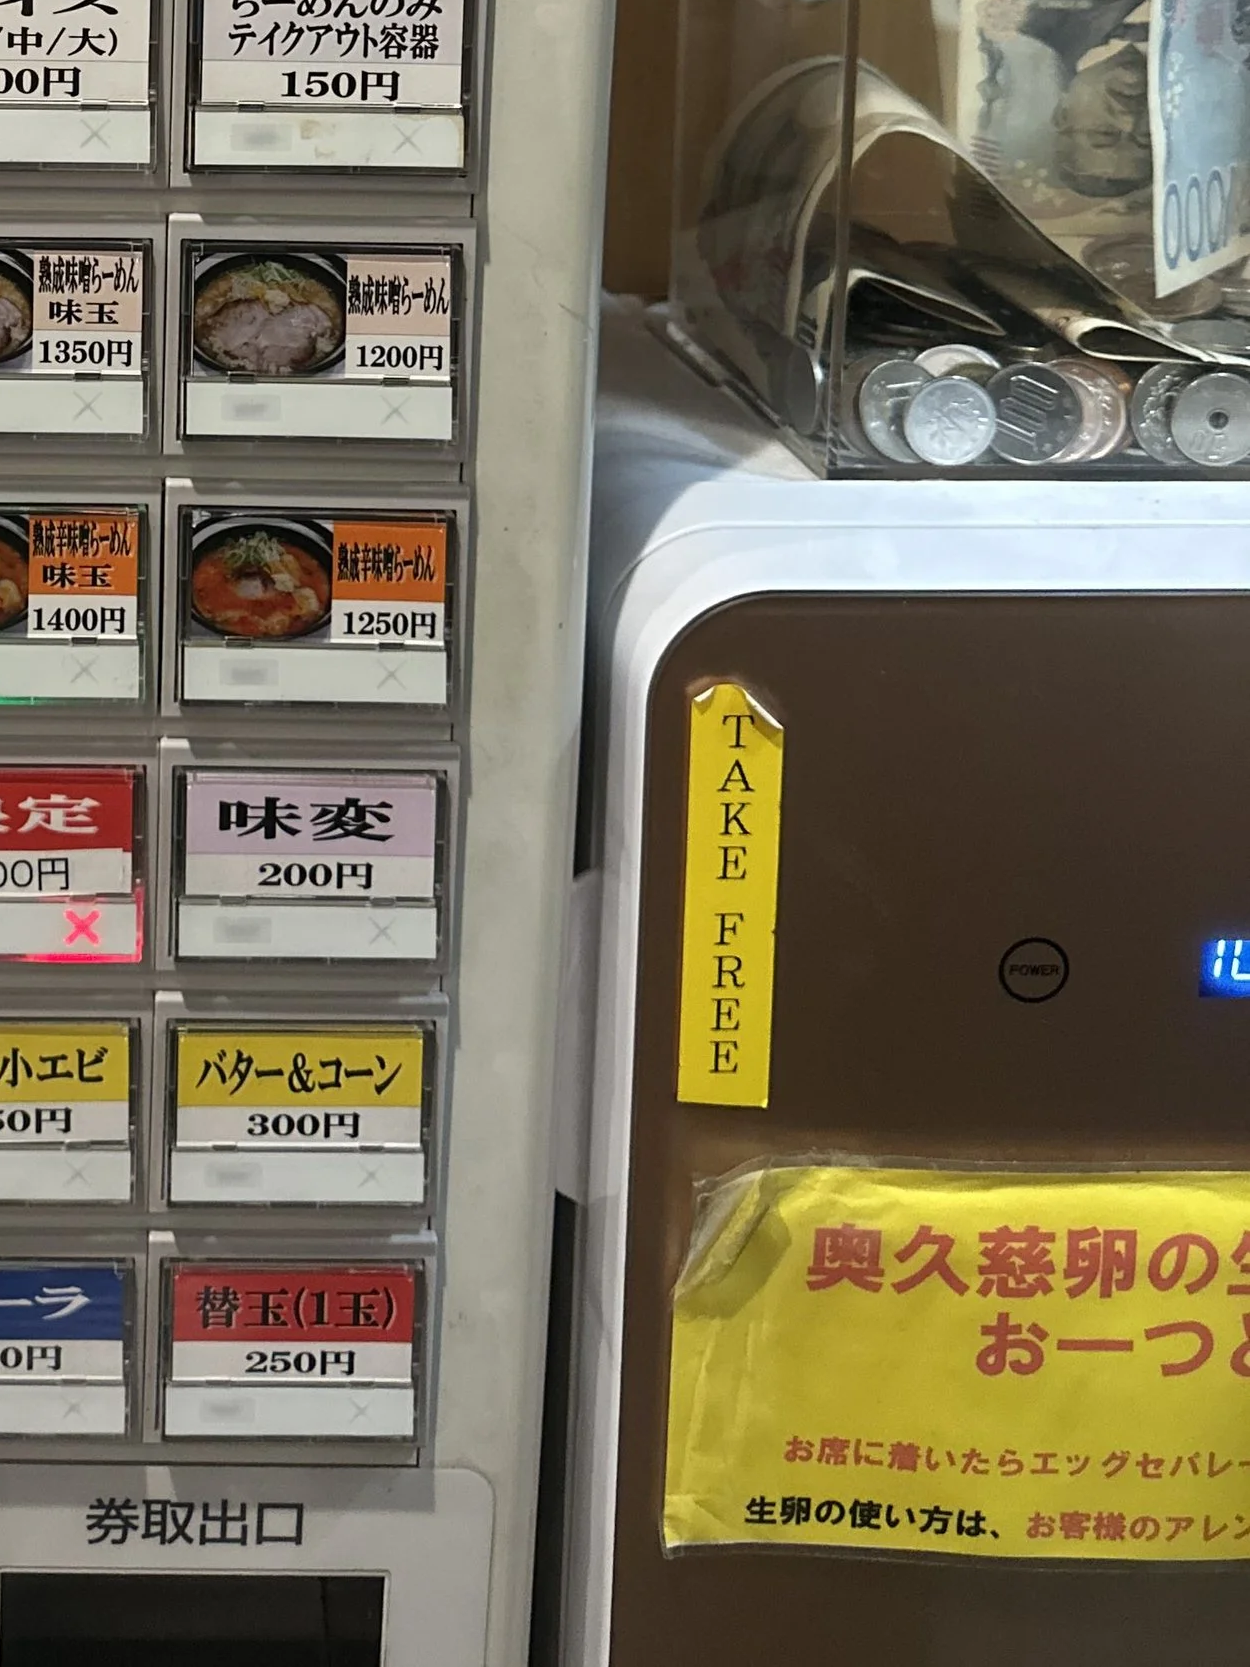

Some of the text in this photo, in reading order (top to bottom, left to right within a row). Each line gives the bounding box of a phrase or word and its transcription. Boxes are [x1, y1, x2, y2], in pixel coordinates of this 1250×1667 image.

[228, 24, 440, 61] テイクアウト容器
[281, 69, 400, 101] 150円
[38, 256, 139, 294] 熟成味噌らーめん
[348, 274, 449, 315] 熟成味噌らーめん
[48, 299, 119, 326] 味玉
[39, 339, 133, 368] 1350円
[356, 344, 444, 371] 1200円
[32, 521, 132, 557] 熟成辛味噌らーめん
[42, 563, 113, 589] 味玉
[337, 542, 436, 583] 熟成辛味噌らーめん
[32, 606, 127, 635] 1400円
[343, 610, 437, 640] 1250円
[218, 796, 396, 843] 味変
[257, 861, 374, 890] 200円
[709, 714, 755, 1074] TAKE FREE
[1008, 964, 1061, 978] POWER
[195, 1048, 403, 1096] バター&コーン
[247, 1112, 361, 1140] 300円
[806, 1222, 1250, 1300] 奥久慈卵の
[195, 1284, 397, 1331] 替玉(1玉)
[244, 1349, 356, 1377] 250円
[86, 1497, 305, 1546] 券取出口
